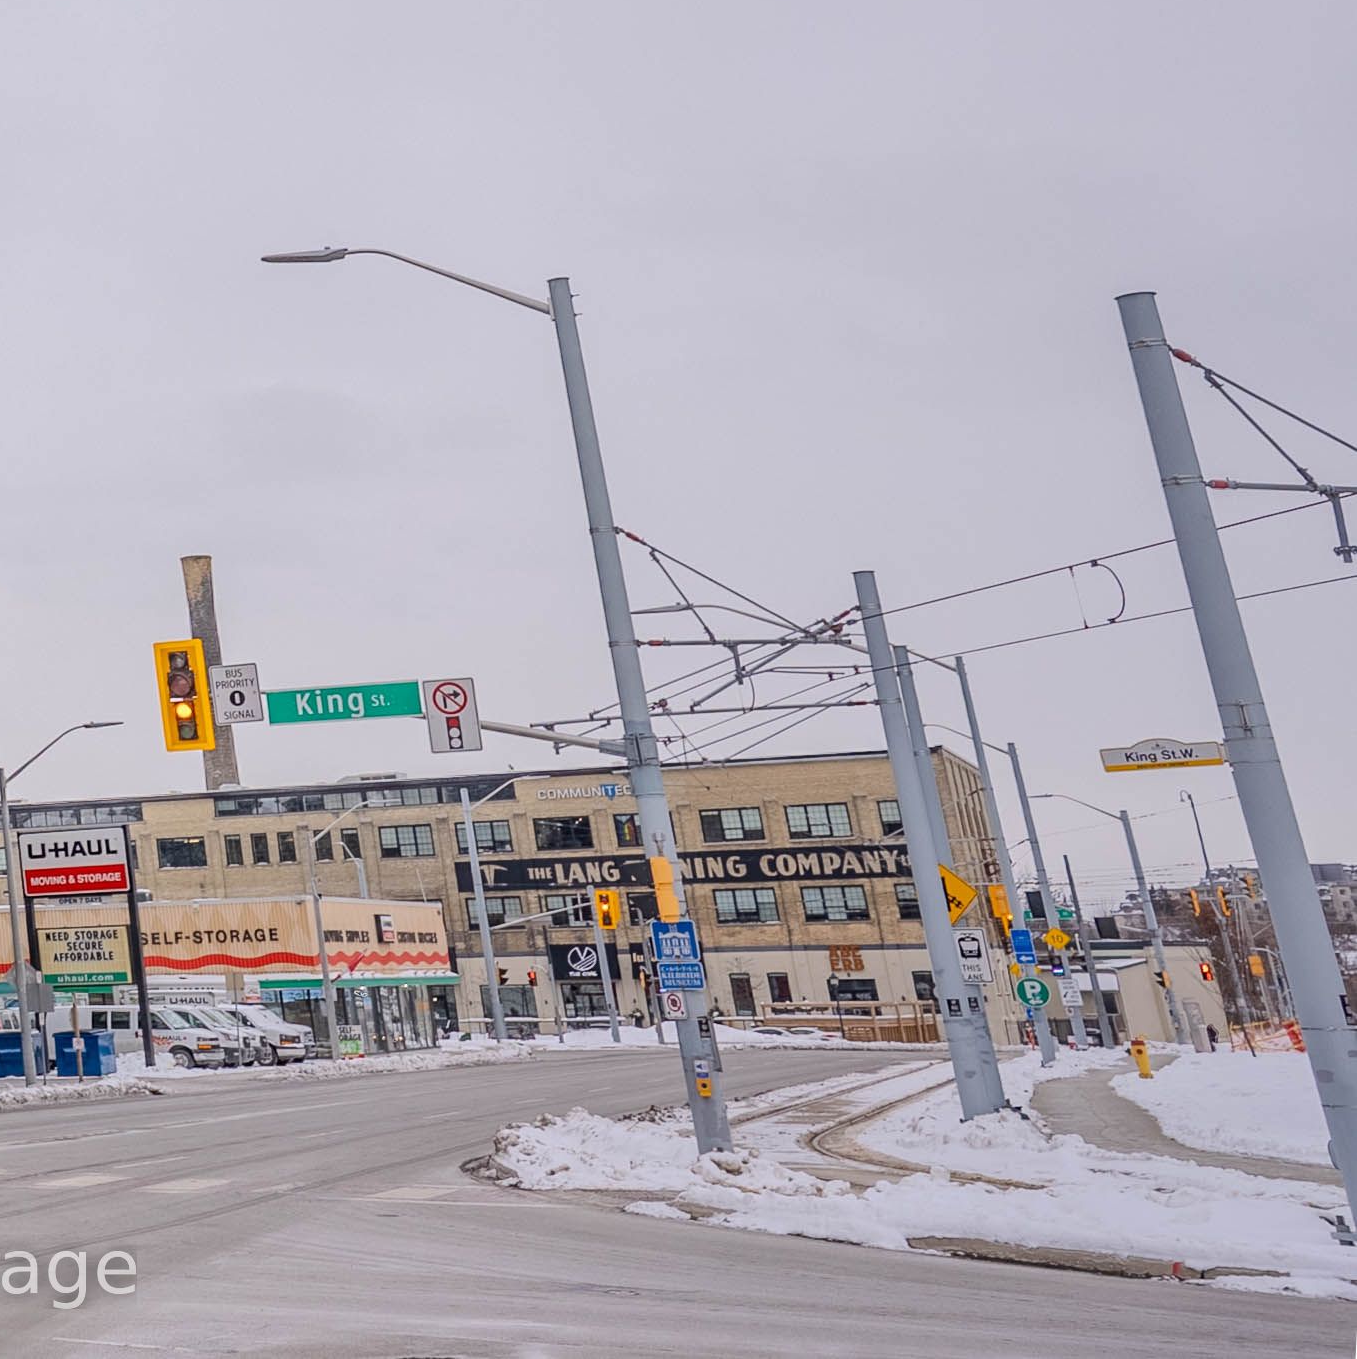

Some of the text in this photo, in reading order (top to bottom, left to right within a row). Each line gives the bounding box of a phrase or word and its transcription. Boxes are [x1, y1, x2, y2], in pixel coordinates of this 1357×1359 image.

[225, 669, 243, 678] BUS
[215, 678, 255, 689] PRIORITY
[295, 690, 391, 718] King St.
[224, 710, 255, 720] SIGNAL
[1124, 751, 1158, 763] King
[537, 784, 632, 800] COMMUNITEC
[27, 839, 118, 859] U-HAUL
[527, 867, 553, 880] THE
[554, 861, 621, 885] LANG
[759, 850, 899, 877] COMPANY
[30, 872, 122, 887] MOVING & STORAGE
[45, 929, 119, 942] NEED STORAGE
[140, 928, 279, 945] SELF-STORAGE
[67, 941, 103, 951] SECURE
[53, 951, 115, 962] AFFORDABLE
[962, 964, 981, 972] THIS
[57, 974, 114, 983] uhaul.com
[169, 996, 209, 1004] U-HAUL
